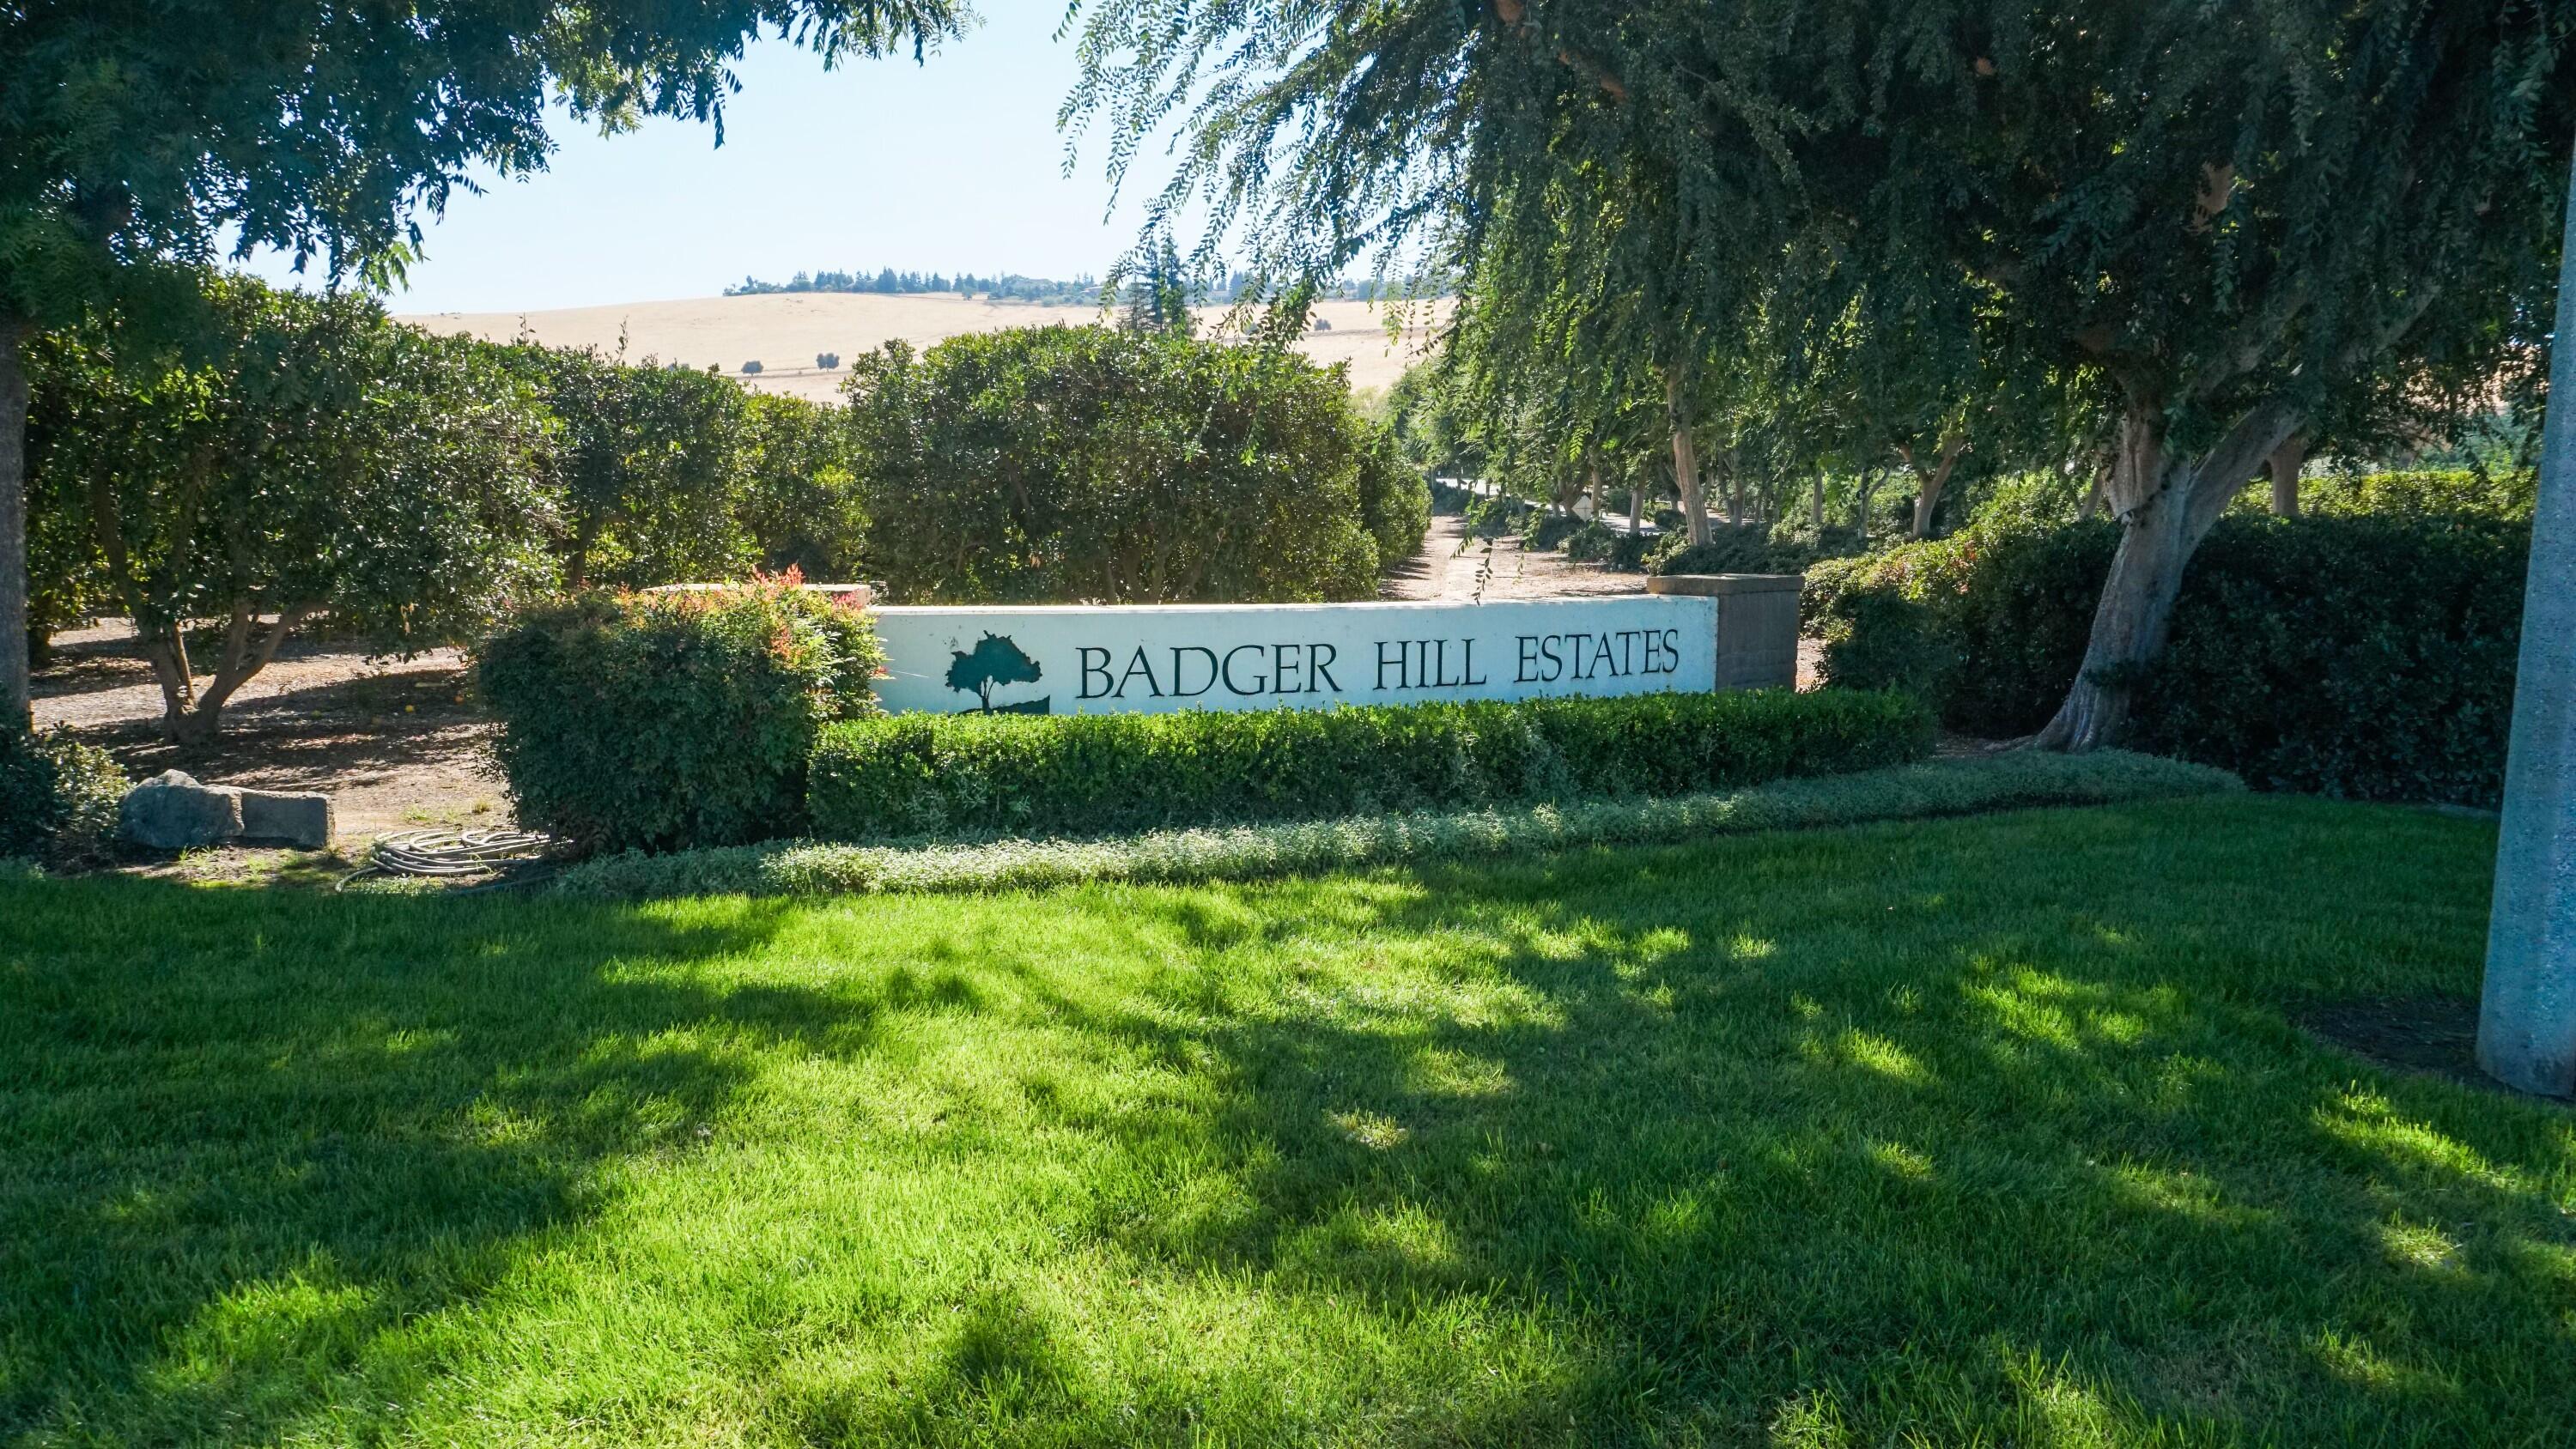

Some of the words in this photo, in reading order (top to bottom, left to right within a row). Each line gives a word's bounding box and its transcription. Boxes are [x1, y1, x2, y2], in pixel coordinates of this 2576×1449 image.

[1075, 643, 1342, 700] BADGER
[1372, 638, 1487, 692] HILL
[1512, 628, 1680, 684] ESTATES
